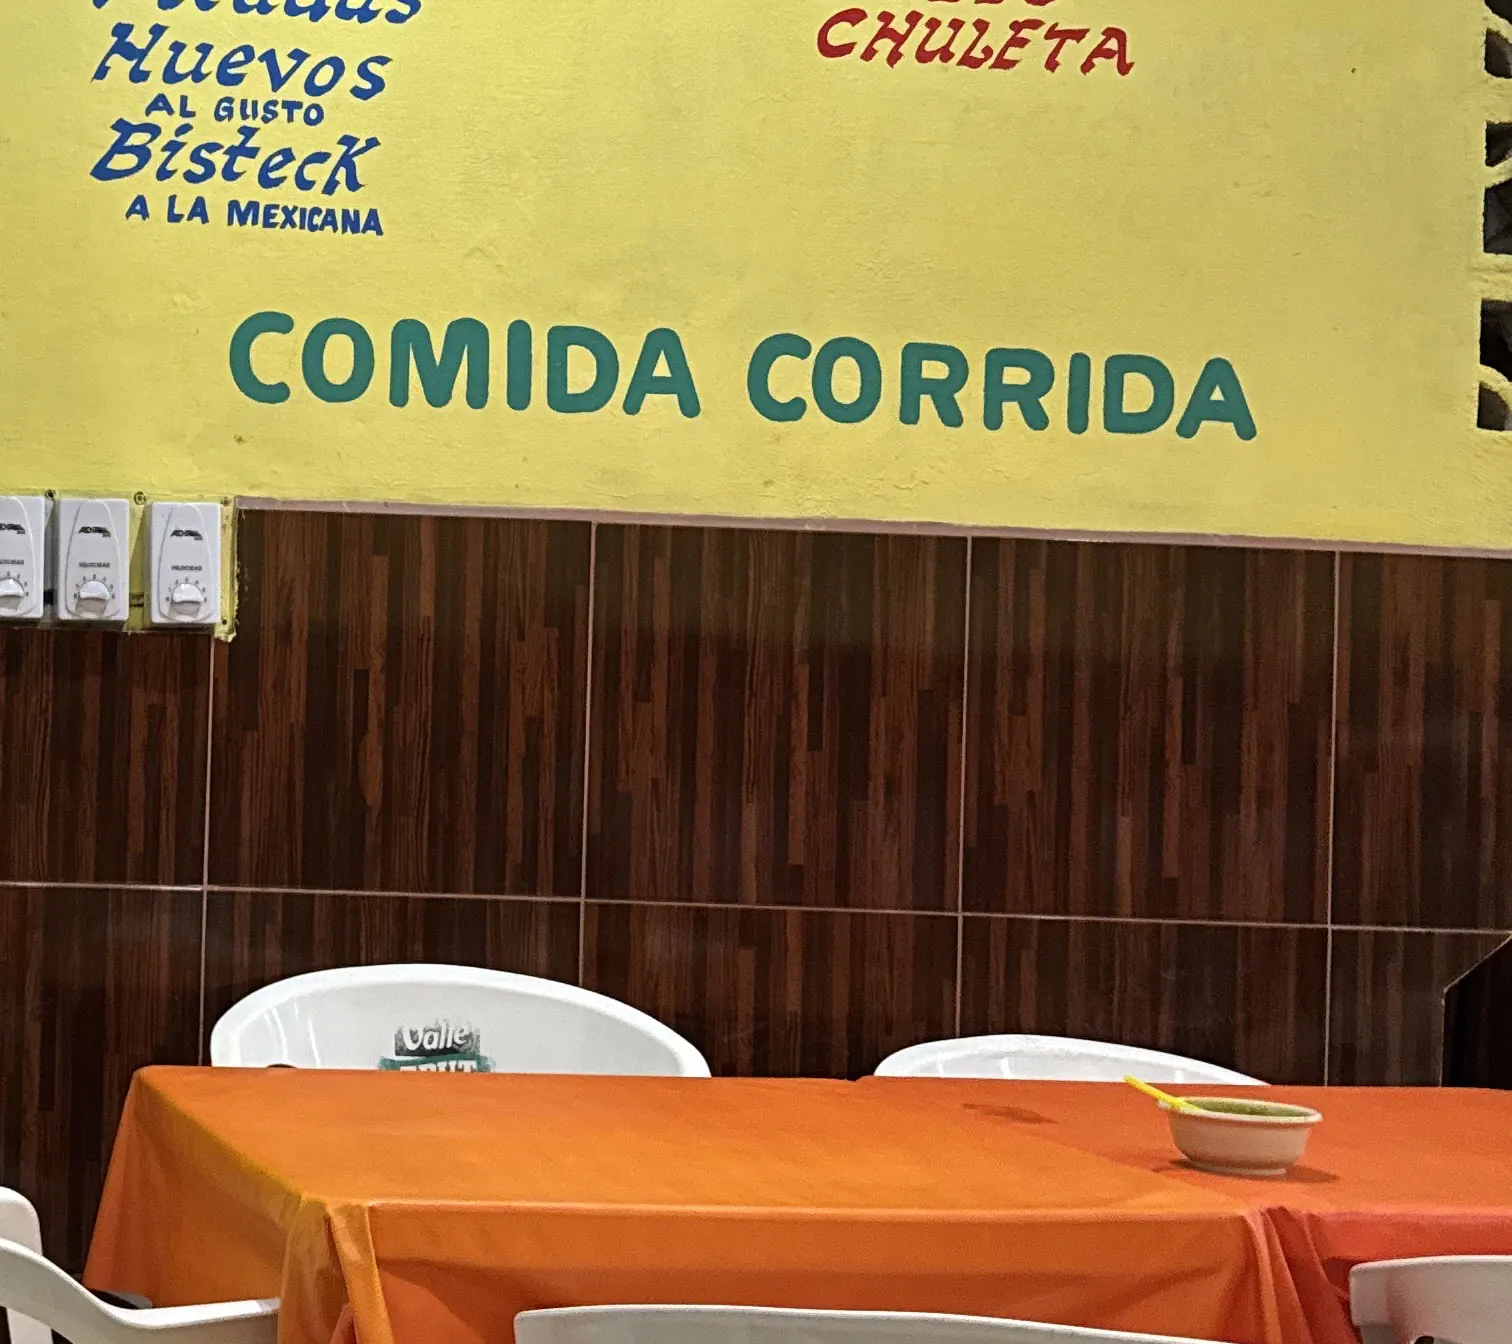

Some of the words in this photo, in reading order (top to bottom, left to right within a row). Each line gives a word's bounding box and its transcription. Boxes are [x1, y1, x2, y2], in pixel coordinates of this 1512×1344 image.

[90, 22, 393, 101] Huevos
[815, 7, 1135, 77] CHULETA
[145, 93, 196, 119] AL
[213, 96, 326, 127] GUSTO
[125, 194, 150, 221] A
[167, 194, 210, 225] LA
[227, 199, 384, 236] MEXICANA
[228, 310, 701, 419] COMIDA
[746, 332, 1258, 442] CORRIDA
